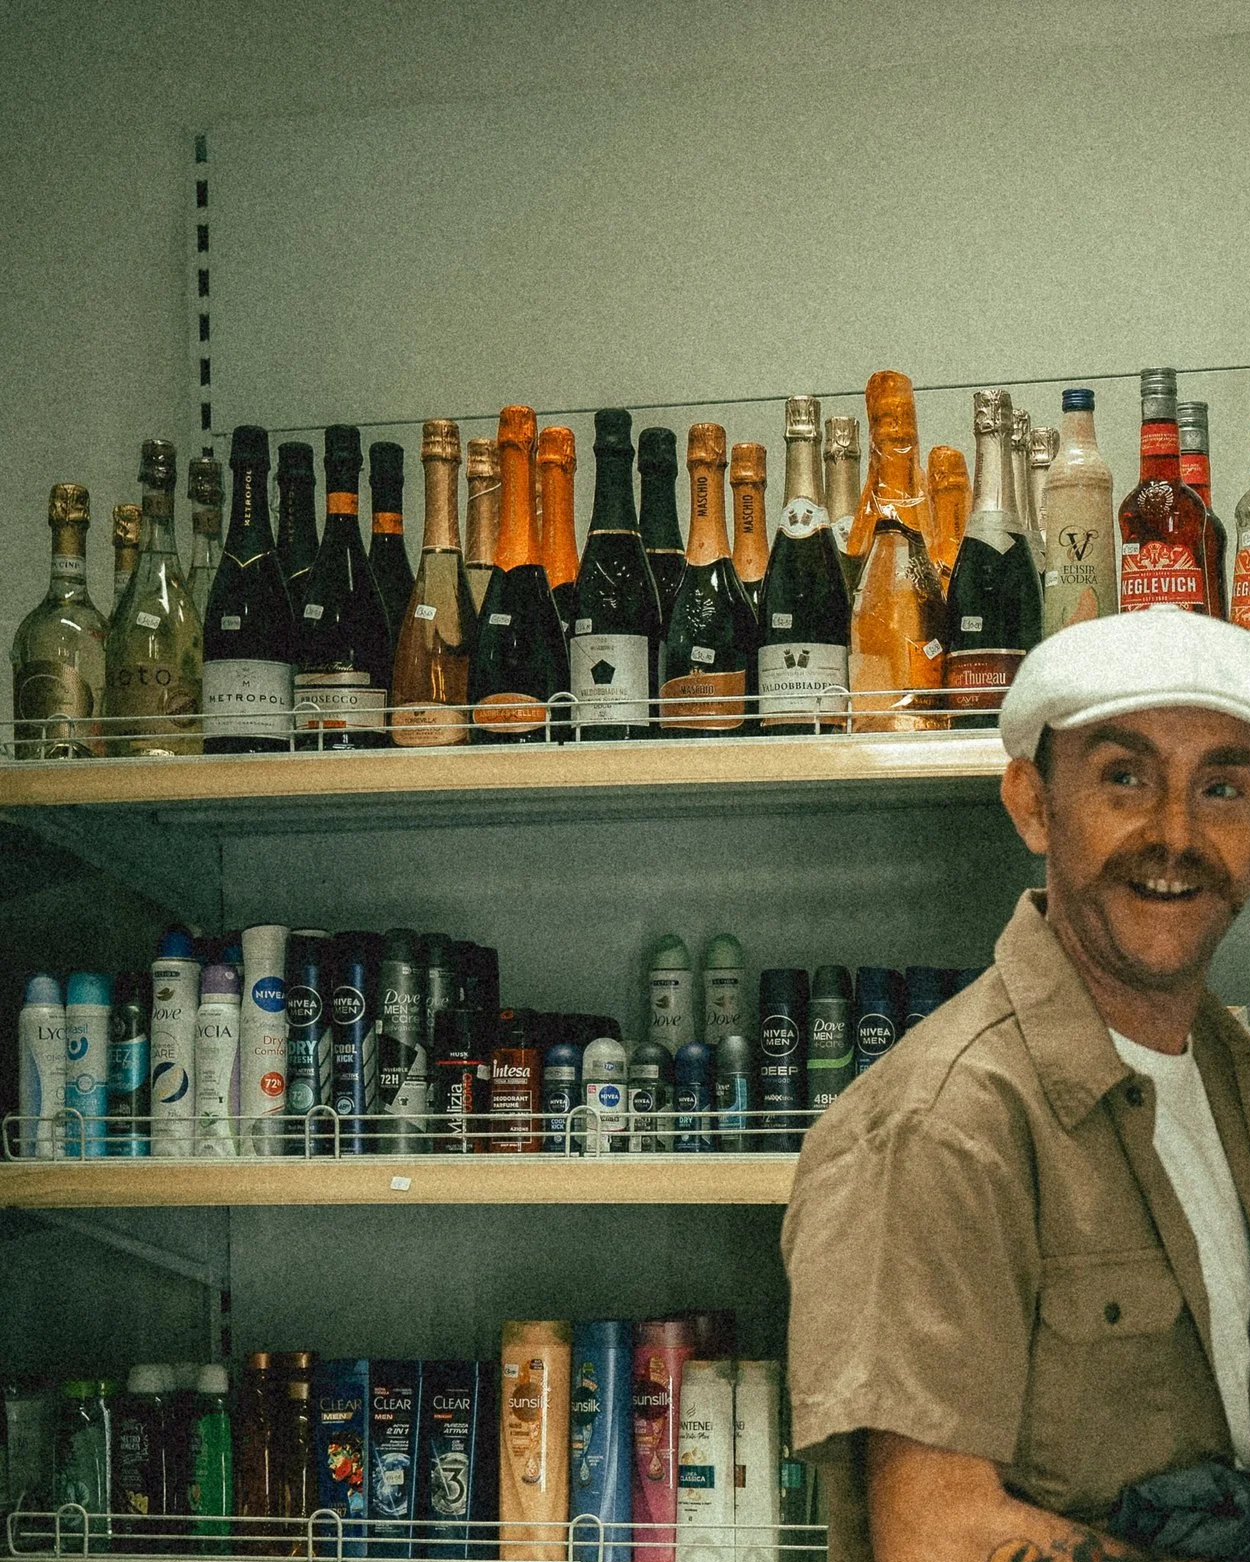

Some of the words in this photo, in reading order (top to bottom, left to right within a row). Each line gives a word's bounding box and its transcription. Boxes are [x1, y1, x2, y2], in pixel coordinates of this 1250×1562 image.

[697, 476, 708, 517] MASCHIO
[742, 494, 753, 534] MASCHIO
[1062, 564, 1096, 575] ELISIR
[1059, 574, 1099, 585] VODKA
[1121, 577, 1197, 596] KEGLEVICH
[208, 693, 286, 705] METROPOL
[255, 990, 286, 1000] NIVEA
[383, 988, 421, 1005] Dove
[383, 1005, 408, 1014] MEN
[813, 1017, 846, 1032] Dove
[763, 1029, 795, 1038] NIVEA
[813, 1032, 833, 1041] MEN
[859, 1027, 891, 1037] NIVEA
[262, 1035, 284, 1046] Dry
[766, 1038, 791, 1046] MEN
[862, 1037, 887, 1045] MEN
[287, 1040, 318, 1055] DRY
[333, 1043, 358, 1055] COOL
[492, 1059, 531, 1079] Intesa
[760, 1066, 799, 1076] DEEP
[379, 1073, 400, 1085] 72H
[373, 1396, 412, 1412] CLEAR
[433, 1396, 471, 1411] CLEAR
[508, 1394, 551, 1410] sunsilk
[632, 1392, 674, 1407] sunsilk
[444, 1466, 466, 1503] 3
